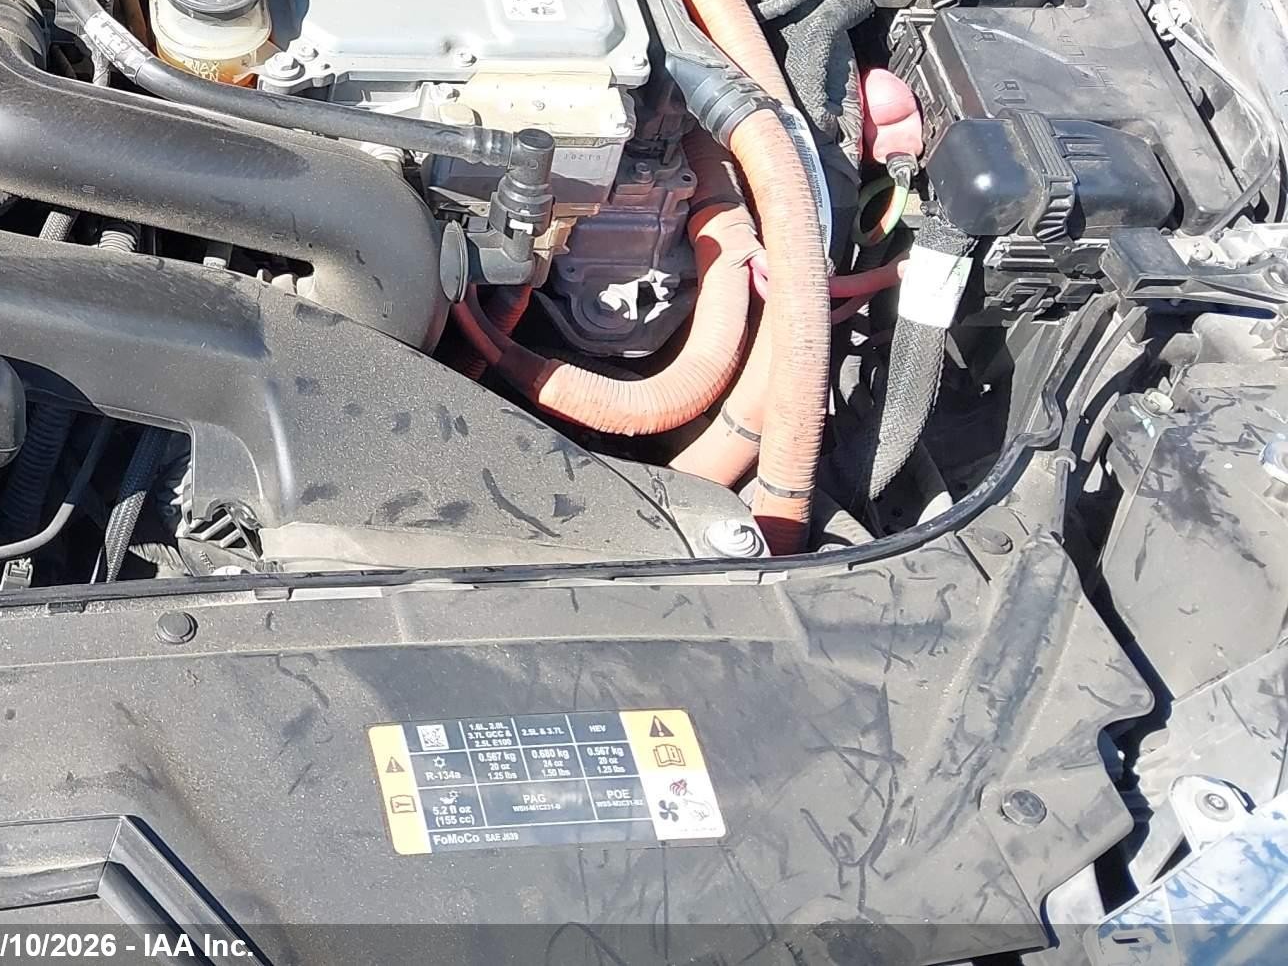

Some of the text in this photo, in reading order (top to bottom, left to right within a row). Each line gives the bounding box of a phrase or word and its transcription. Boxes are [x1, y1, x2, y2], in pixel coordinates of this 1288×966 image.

[588, 724, 607, 733] HEV
[557, 748, 570, 760] kg
[611, 746, 625, 757] kg
[503, 751, 517, 763] kg
[489, 762, 500, 771] 20
[612, 765, 626, 773] lbs
[424, 770, 462, 781] R-134a
[487, 771, 518, 781] 1.25 lbs
[558, 768, 571, 776] lbs
[523, 794, 547, 804] PAG
[606, 789, 631, 800] POE
[432, 806, 472, 815] 5.2 fl oz
[436, 814, 476, 827] (155 cc)
[433, 834, 481, 846] FoMoCo
[485, 834, 500, 842] SAE
